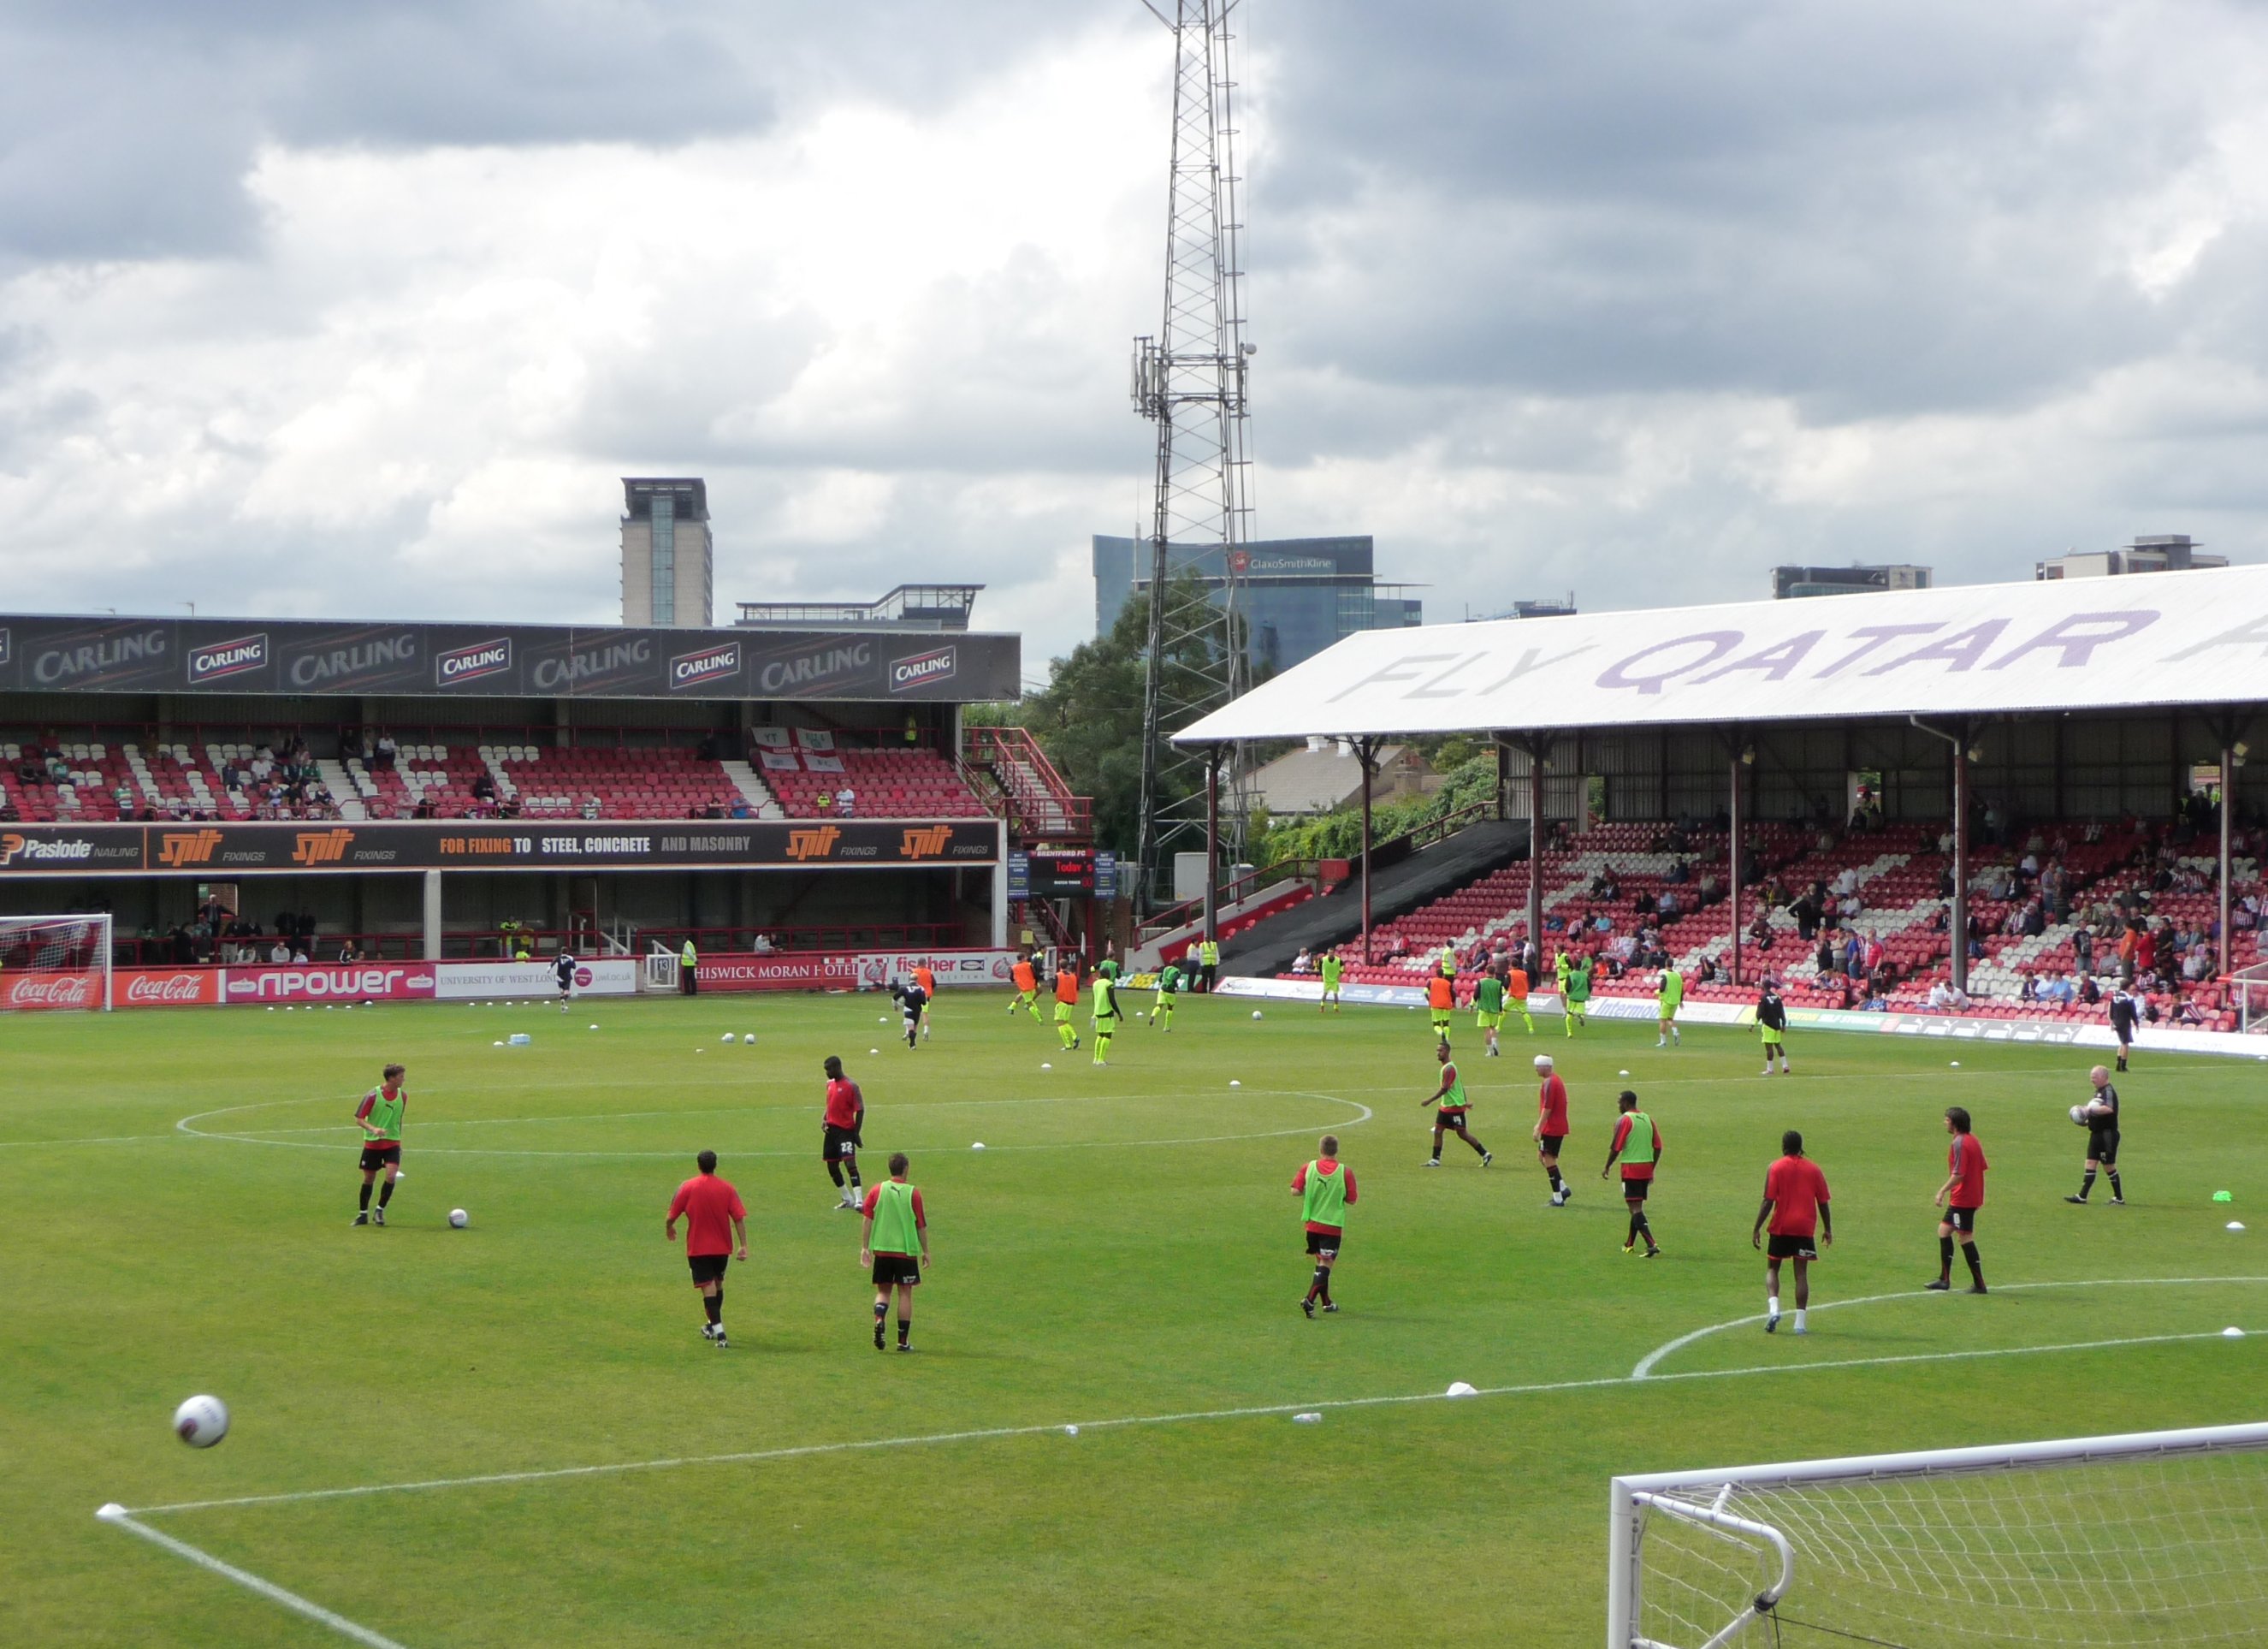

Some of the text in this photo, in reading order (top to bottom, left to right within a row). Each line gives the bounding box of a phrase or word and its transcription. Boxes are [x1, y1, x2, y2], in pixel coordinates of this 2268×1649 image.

[33, 629, 165, 683] CARLING
[195, 644, 261, 672] CARLING
[290, 633, 415, 685] CARLING
[443, 648, 505, 675] CARLING
[533, 638, 651, 689] CARLING
[676, 652, 735, 679] CARLING
[1324, 643, 1601, 703] FLY
[1595, 609, 2162, 695] QATAR
[761, 642, 871, 691] CARLING
[896, 655, 950, 681] CARLING
[24, 839, 91, 858] Paslode
[94, 847, 139, 857] NAILING
[440, 836, 751, 854] FOR FIXING TO STEEL, CONCRETE AND MASONRY
[840, 846, 878, 856] FIXINGS
[952, 845, 988, 854] FIXINGS
[222, 851, 266, 862] FIXINGS
[353, 851, 396, 860] FIXINGS
[658, 959, 669, 971] 13
[896, 956, 956, 972] fisher
[1068, 953, 1076, 964] 14
[440, 976, 493, 985] UNIVERSITY
[494, 975, 507, 984] OF
[509, 974, 534, 983] WEST
[535, 973, 557, 983] LON
[694, 966, 755, 980] HISWICK
[758, 965, 809, 978] MORAN
[127, 974, 204, 1001] Coca-Cola
[258, 970, 405, 997] npower
[841, 1142, 853, 1153] 22
